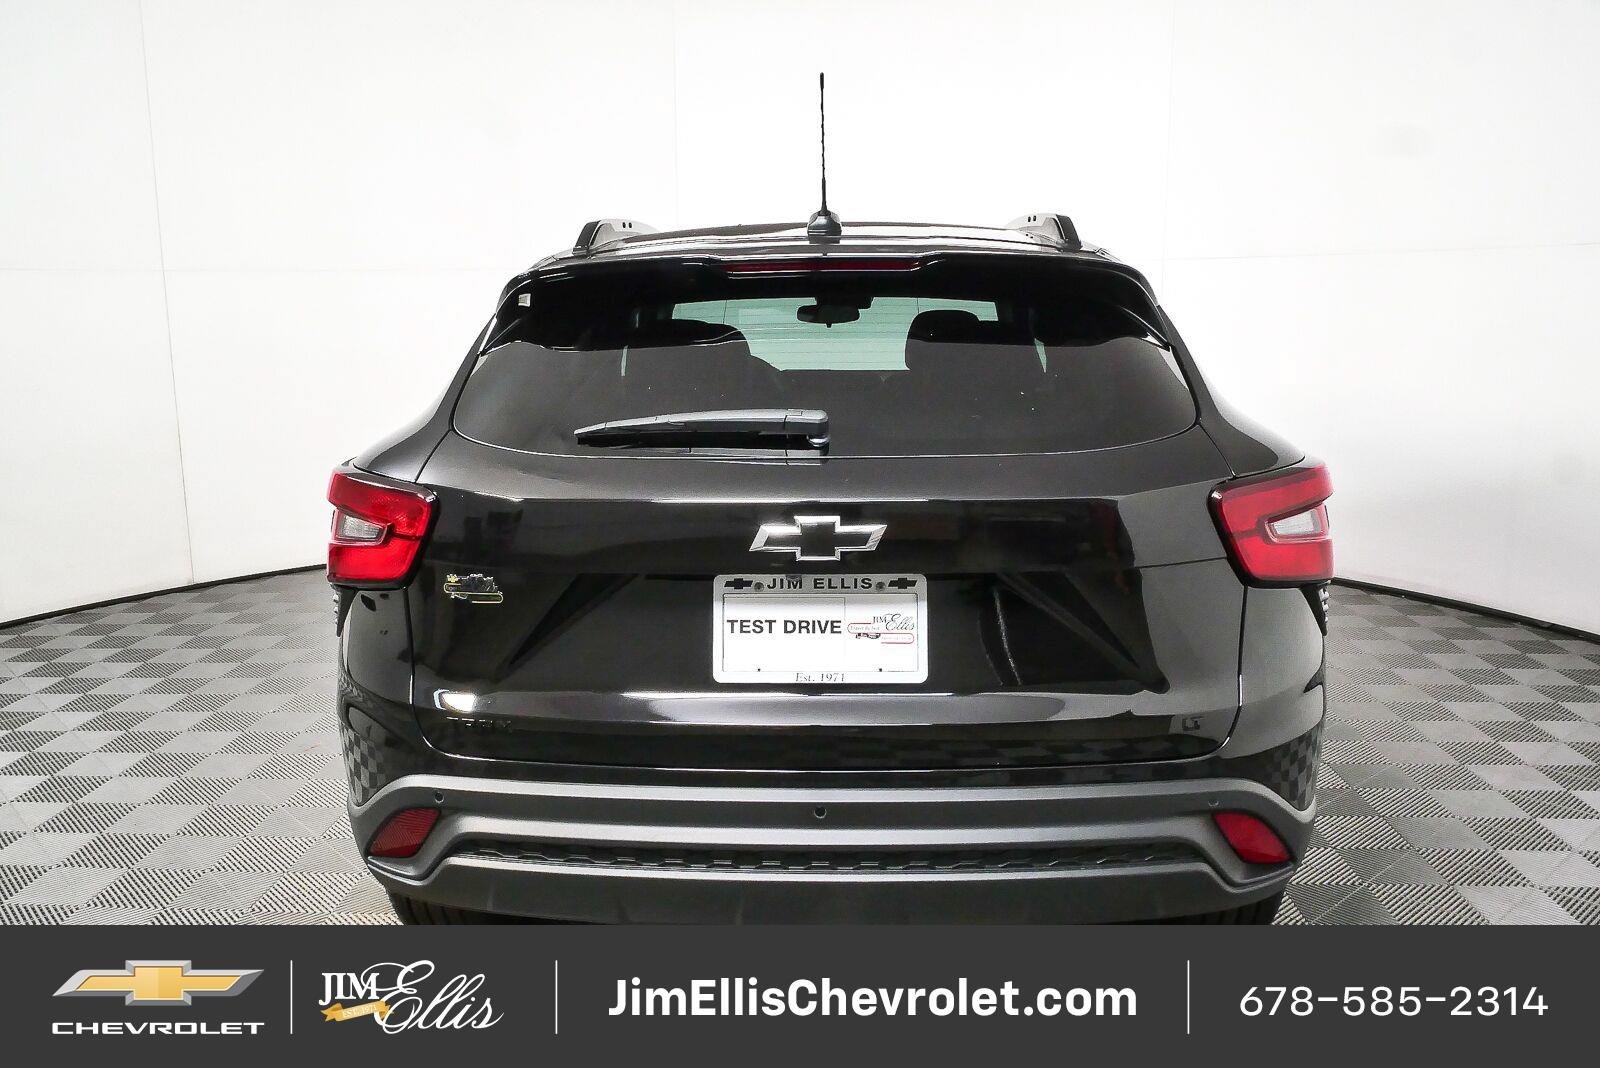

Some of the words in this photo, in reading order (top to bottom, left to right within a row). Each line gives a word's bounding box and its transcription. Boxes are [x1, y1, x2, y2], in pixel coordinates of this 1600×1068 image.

[767, 577, 803, 590] JIM
[813, 577, 873, 590] ELLIS
[727, 619, 777, 634] TEST
[783, 619, 842, 634] DRIVE
[873, 616, 887, 624] JIM
[884, 613, 915, 631] Ellis
[820, 672, 845, 682] 1971
